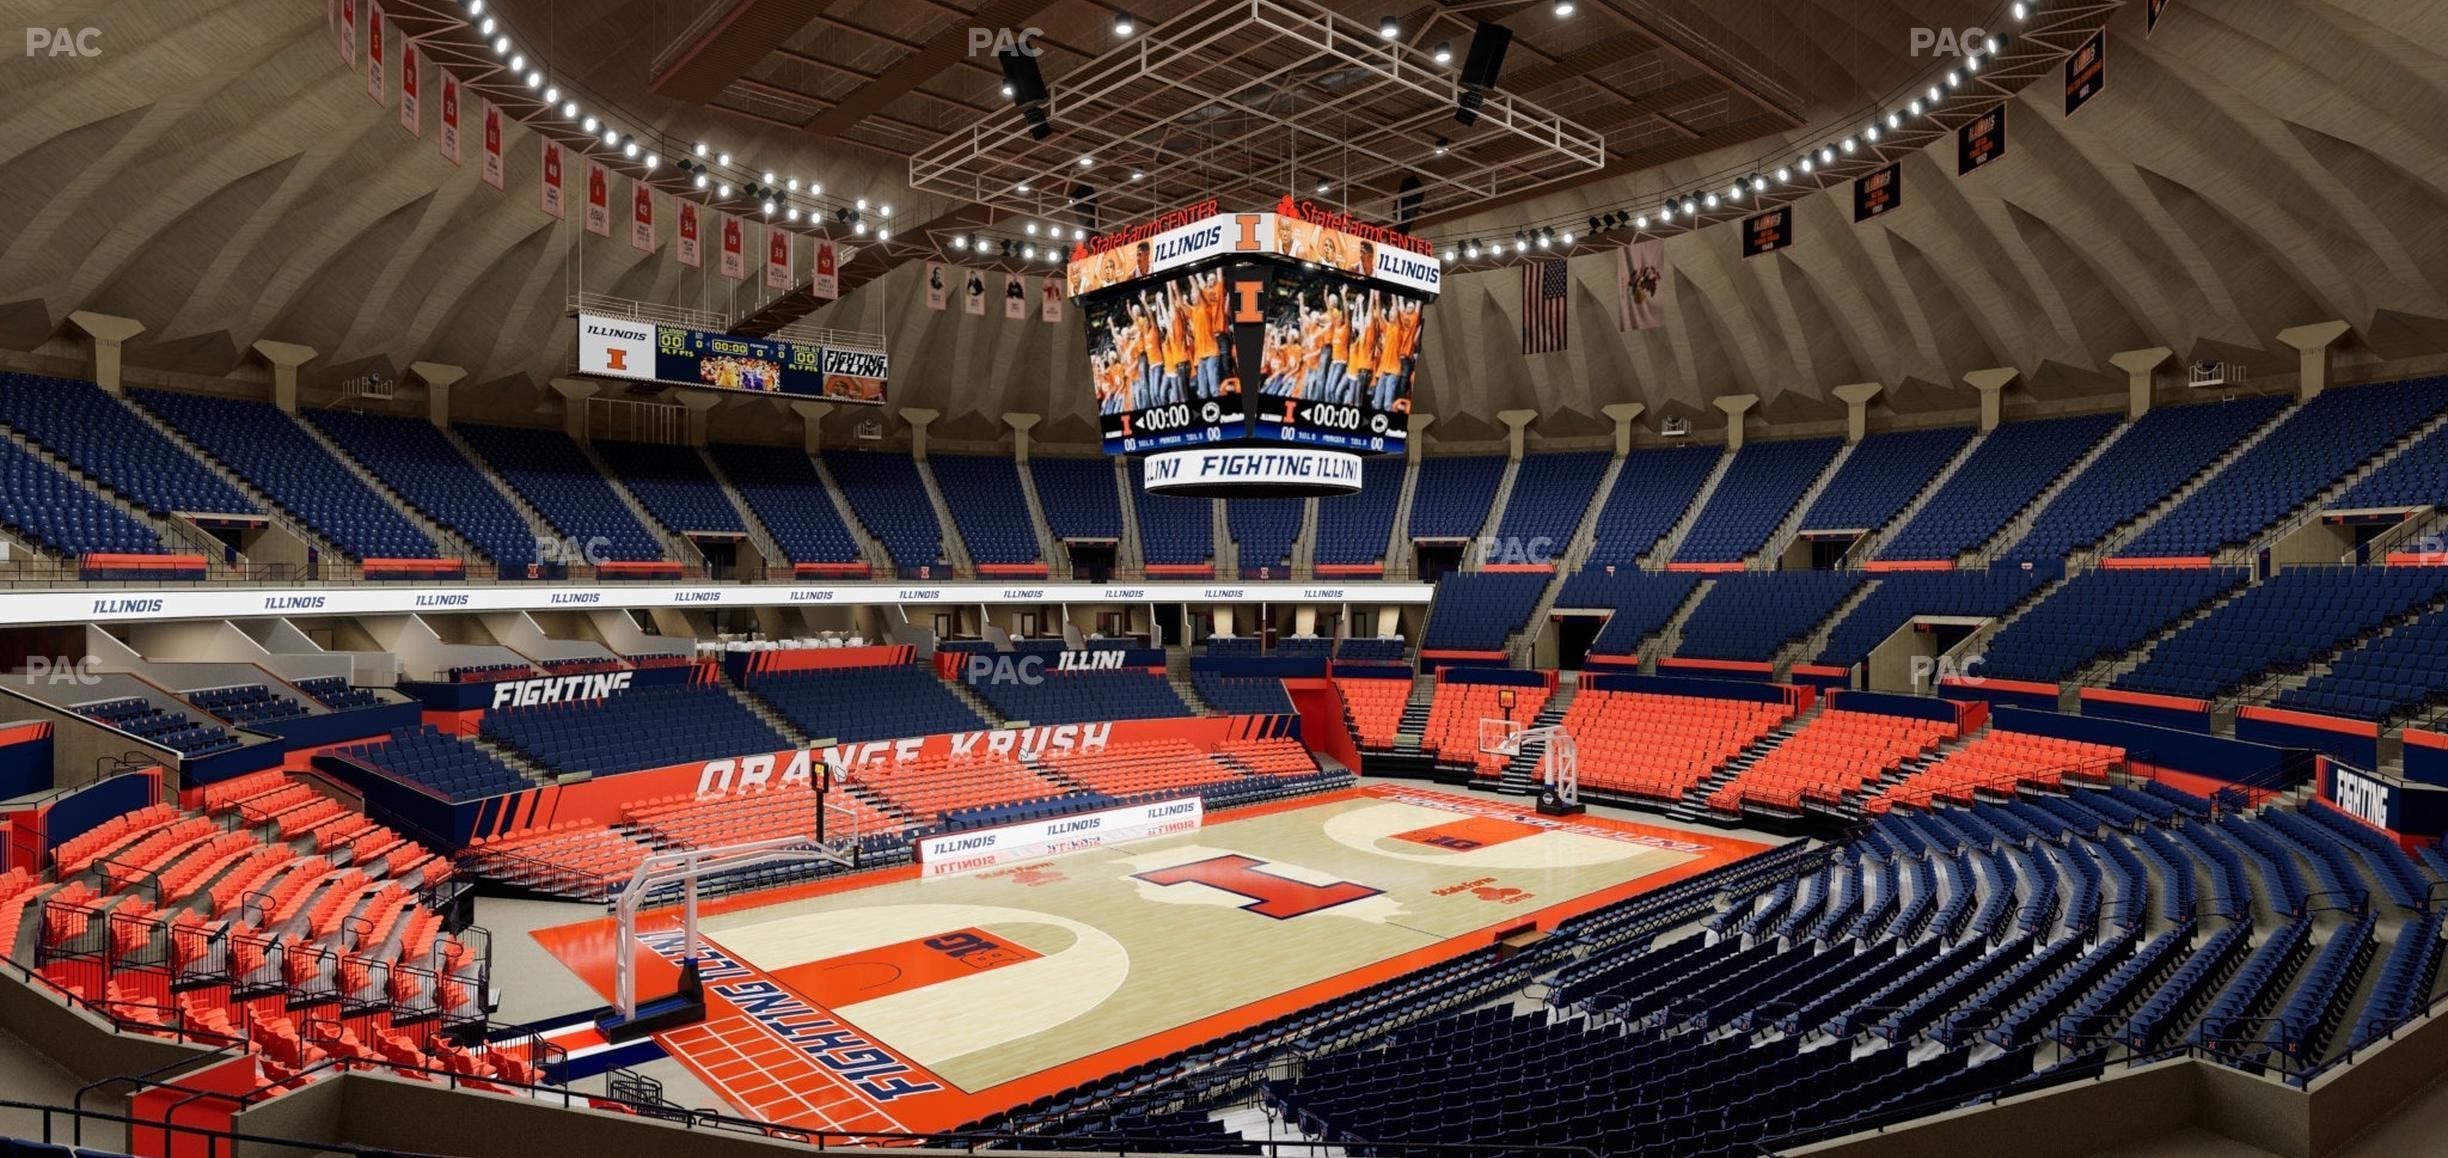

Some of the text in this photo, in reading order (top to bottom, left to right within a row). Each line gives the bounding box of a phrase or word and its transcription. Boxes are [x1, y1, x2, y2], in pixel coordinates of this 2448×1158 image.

[1154, 225, 1222, 263] ILLINOIS
[1378, 253, 1439, 284] ILLINOIS
[587, 325, 647, 341] ILLINOIS
[826, 350, 886, 367] FIGHTING
[1145, 404, 1190, 431] 00:00
[1313, 403, 1360, 430] 00:00
[1206, 426, 1221, 441] 00
[1281, 426, 1295, 441] 00
[1124, 437, 1136, 451] 00
[1370, 436, 1384, 450] 00
[1200, 455, 1358, 482] FIGHTING ILLINI
[415, 594, 469, 606] ILLINOIS
[551, 592, 600, 604] ILLINOIS
[674, 591, 721, 602] ILLINOIS
[790, 591, 834, 600] ILLINOIS
[899, 590, 940, 599] ILLINOIS
[1003, 589, 1044, 599] ILLINOIS
[1105, 589, 1144, 598] ILLINOIS
[1204, 589, 1243, 598] ILLINOIS
[1303, 589, 1344, 598] ILLINOIS
[93, 599, 163, 614] ILLINOIS
[264, 596, 325, 609] ILLINOIS
[1057, 650, 1126, 671] ILLINI
[2336, 768, 2389, 830] FIGHTING
[1148, 802, 1195, 819] ILLINOIS
[1047, 817, 1101, 836] ILLINOIS
[933, 835, 997, 855] ILLINOIS
[708, 980, 946, 1102] FIGHTING
